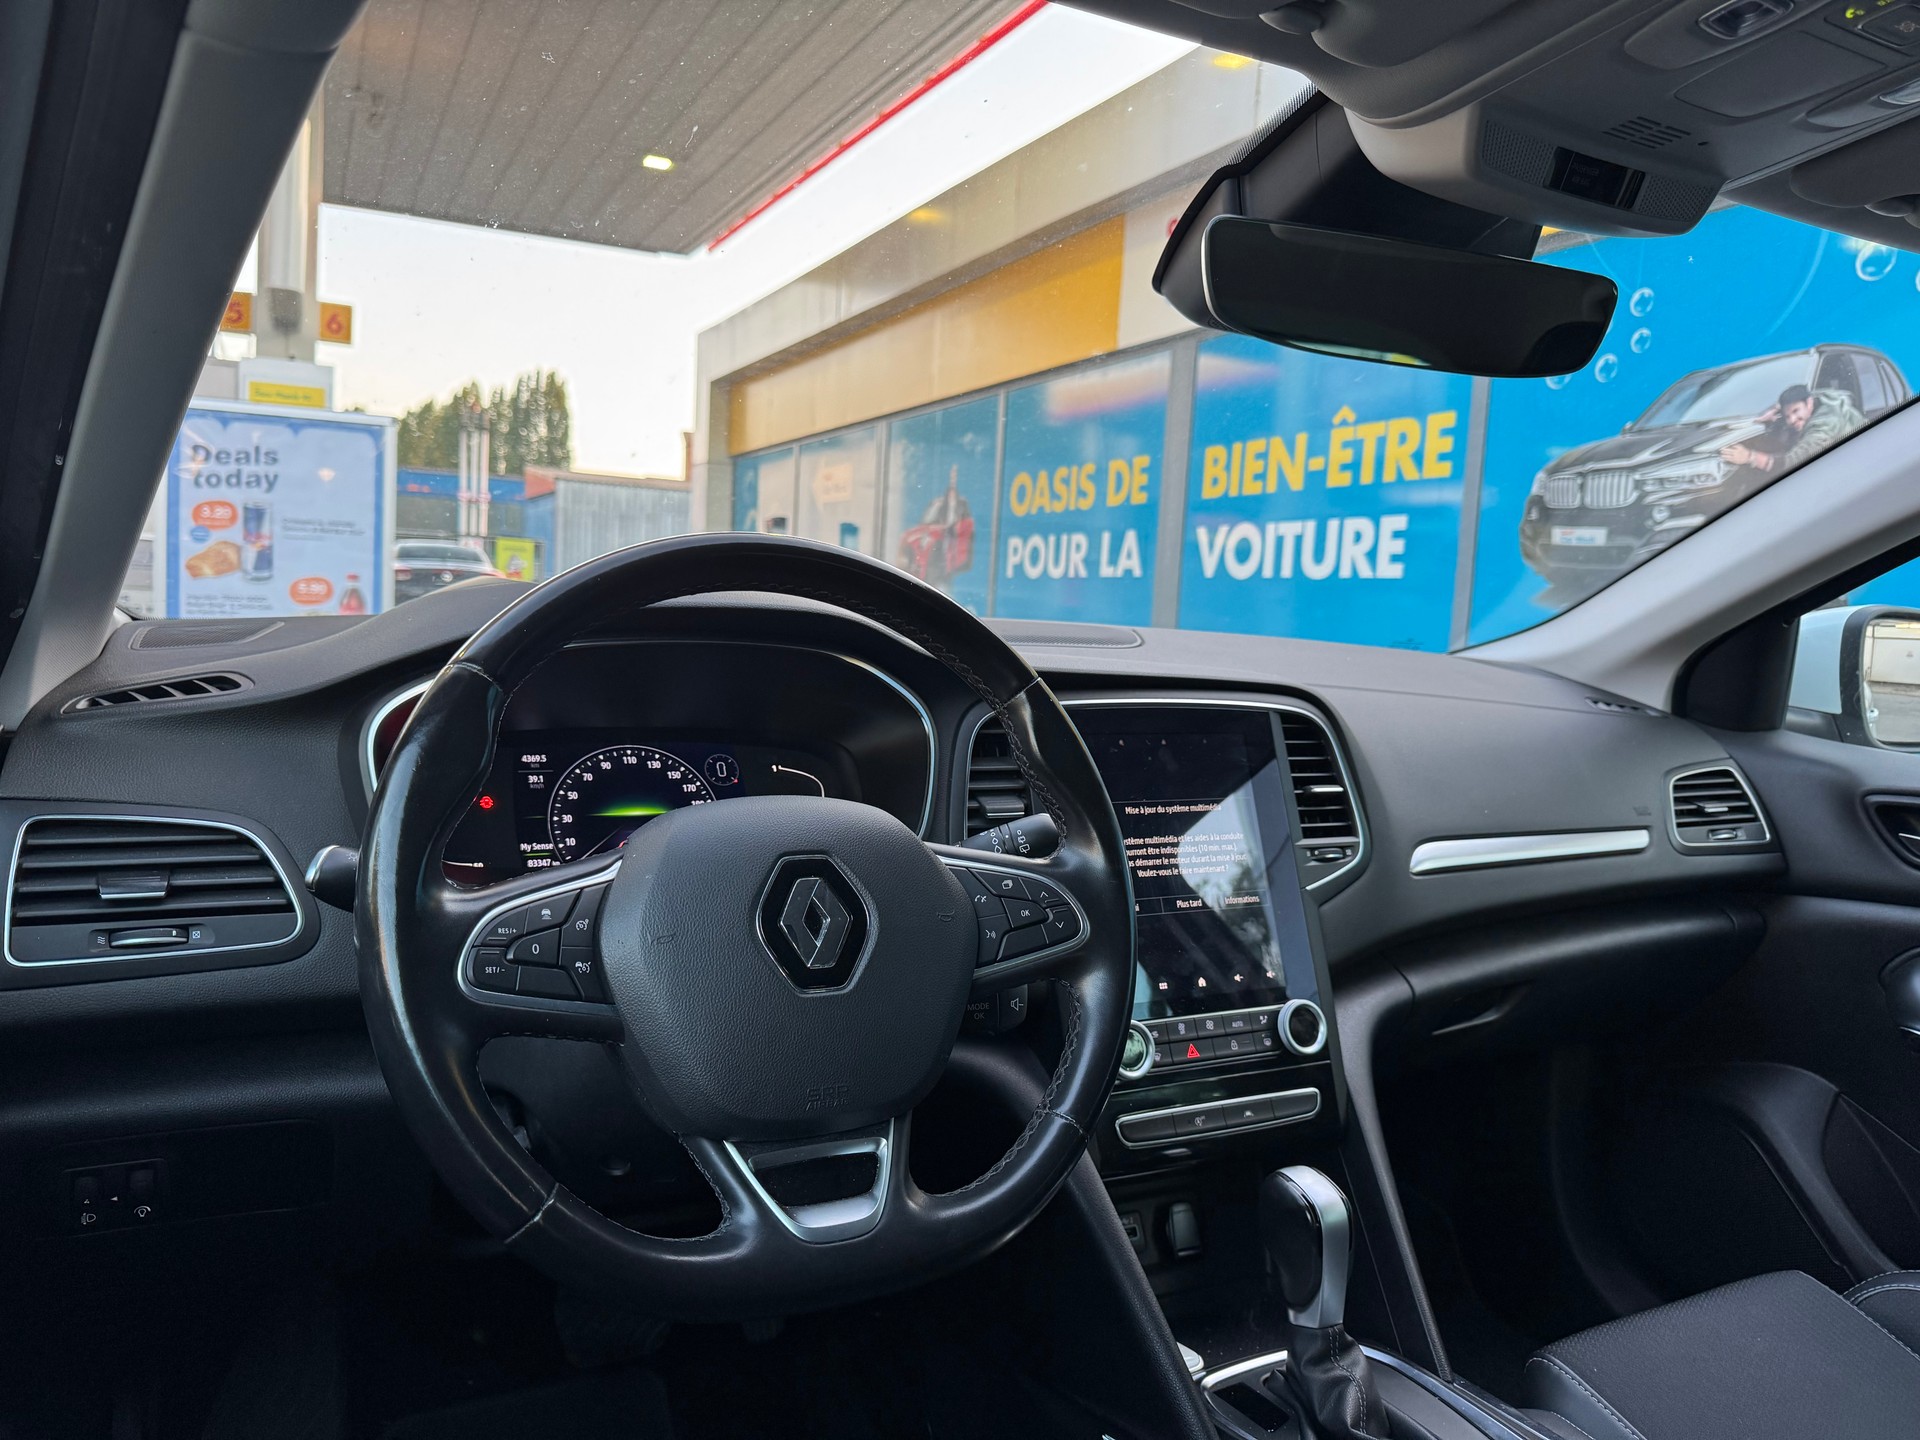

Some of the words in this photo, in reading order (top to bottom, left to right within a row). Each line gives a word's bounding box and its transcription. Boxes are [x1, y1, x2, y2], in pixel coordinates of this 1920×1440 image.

[226, 301, 244, 324] 5
[326, 312, 343, 336] 6
[191, 444, 279, 466] Deals
[1202, 406, 1458, 500] BIEN-ÊTRE
[193, 468, 279, 495] today
[1010, 464, 1097, 517] OASIS
[1105, 455, 1150, 507] DE
[1196, 514, 1409, 580] VOITURE
[1007, 531, 1089, 581] POUR
[1100, 529, 1143, 579] LA
[521, 754, 547, 763] 4369.5
[622, 756, 637, 764] 110
[600, 761, 611, 770] 90
[647, 761, 661, 769] 130
[527, 775, 544, 783] 39.1
[582, 773, 594, 781] 70
[667, 771, 681, 779] 150
[682, 784, 696, 792] 170
[567, 791, 578, 800] 50
[1125, 806, 1139, 815] Mise
[1140, 805, 1145, 814] à
[1145, 805, 1156, 815] jour
[1157, 805, 1165, 813] du
[1166, 804, 1190, 815] système
[1190, 803, 1222, 812] multimédia
[561, 814, 573, 823] 30
[564, 837, 576, 846] 10
[1144, 834, 1178, 844] multimédia
[1178, 834, 1185, 843] et
[1185, 833, 1194, 842] les
[520, 843, 532, 852] My
[532, 842, 554, 850] Sense
[1148, 846, 1160, 856] être
[1160, 845, 1198, 856] indisponibles
[526, 859, 552, 868] 83347
[1135, 857, 1163, 867] démarrer
[1163, 856, 1169, 865] le
[1169, 856, 1191, 865] moteur
[1137, 868, 1172, 878] Voulez-vous
[1172, 867, 1179, 876] le
[1179, 866, 1193, 875] faire
[1193, 865, 1225, 874] maintenant
[1176, 900, 1189, 909] Plus
[1189, 898, 1202, 908] tard
[1225, 895, 1260, 904] Informations
[1020, 909, 1031, 917] OK
[531, 943, 540, 955] 0
[967, 1002, 990, 1012] MODE
[974, 1012, 985, 1020] OK
[1231, 1019, 1244, 1028] AUTO
